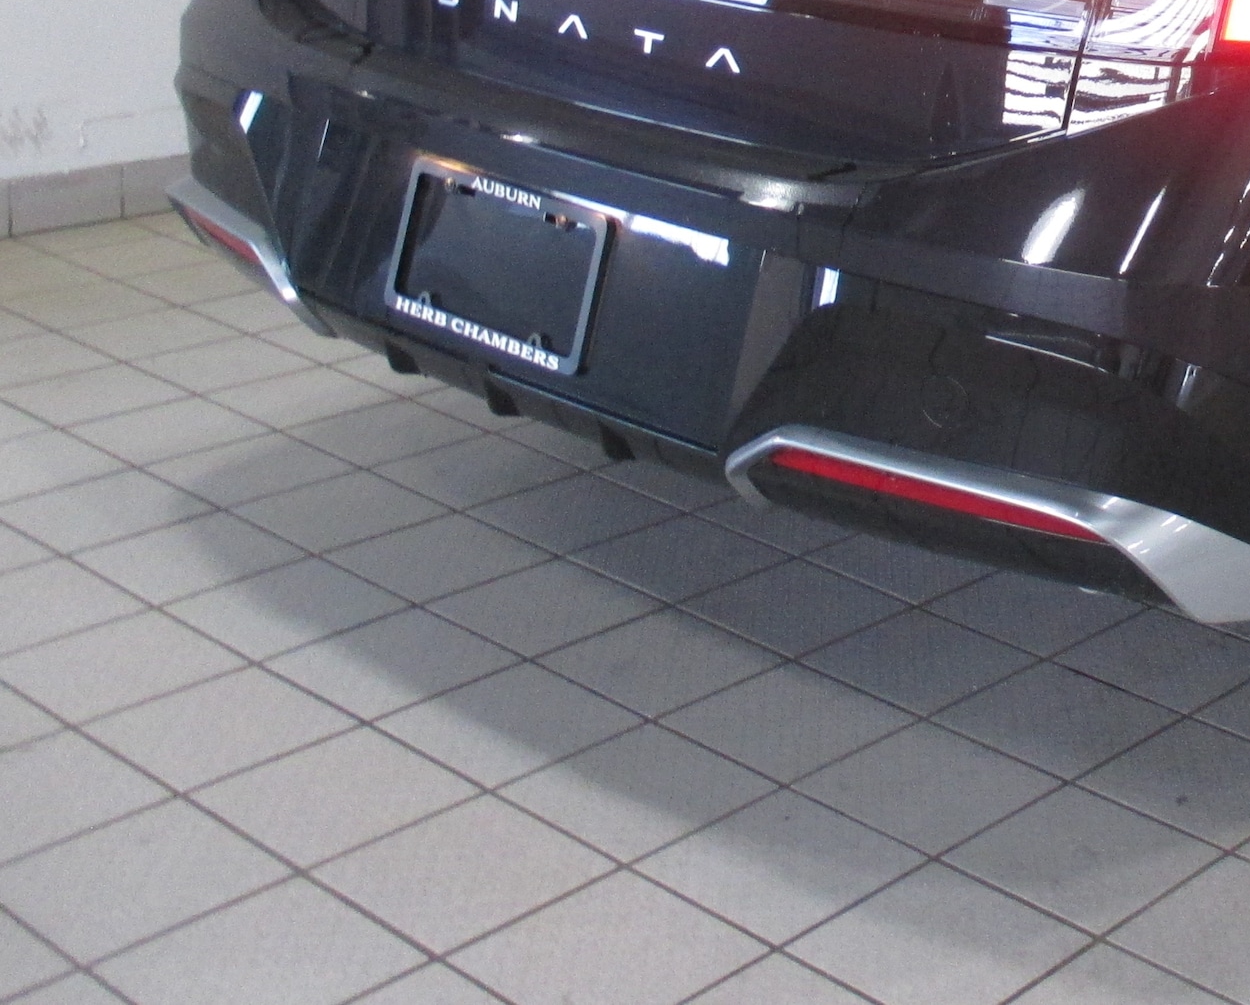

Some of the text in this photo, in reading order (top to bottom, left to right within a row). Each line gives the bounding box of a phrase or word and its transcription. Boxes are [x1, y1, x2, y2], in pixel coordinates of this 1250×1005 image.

[471, 176, 541, 210] AUBURN
[395, 296, 560, 371] HERB CHAMBERS
